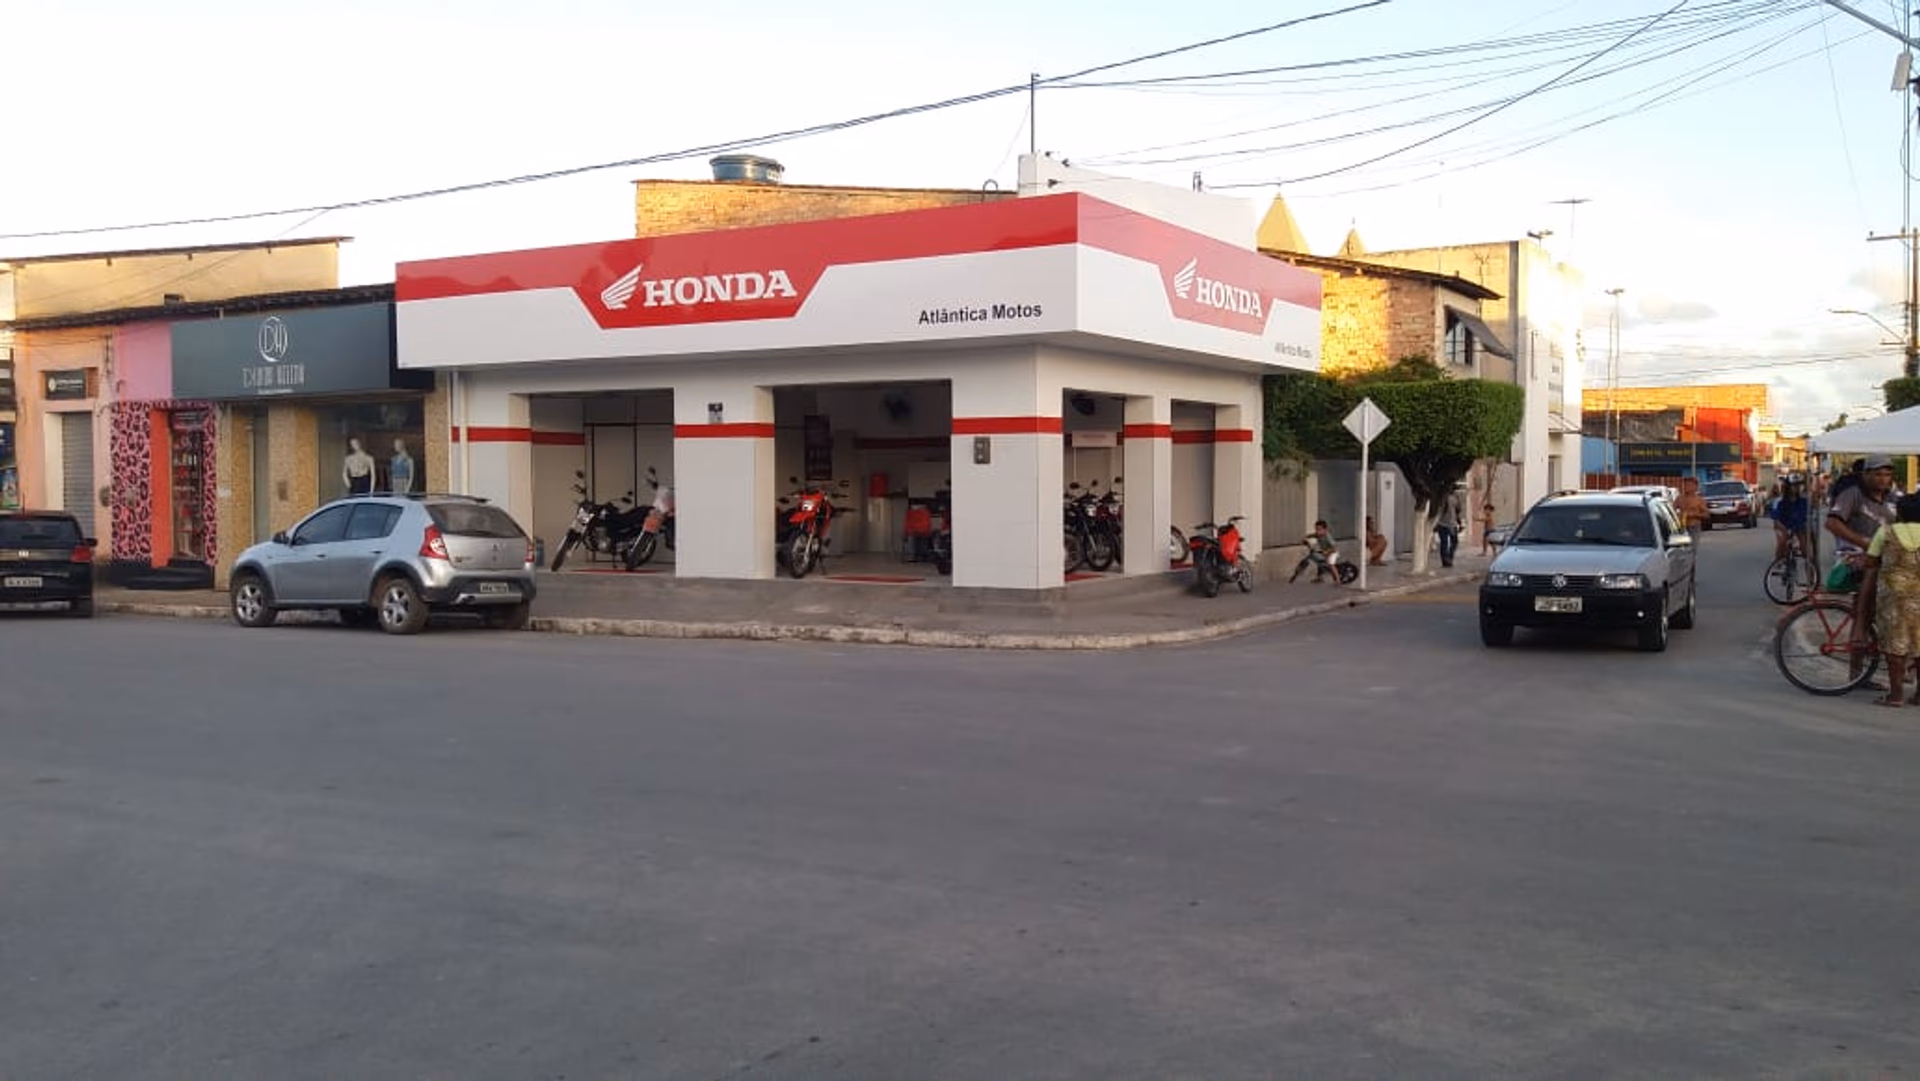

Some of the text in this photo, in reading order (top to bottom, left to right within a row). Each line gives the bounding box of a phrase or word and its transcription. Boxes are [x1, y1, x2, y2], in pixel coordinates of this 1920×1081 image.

[642, 269, 798, 307] HONDA
[1196, 277, 1263, 318] HONDA
[918, 303, 1043, 325] Atlântica Motos
